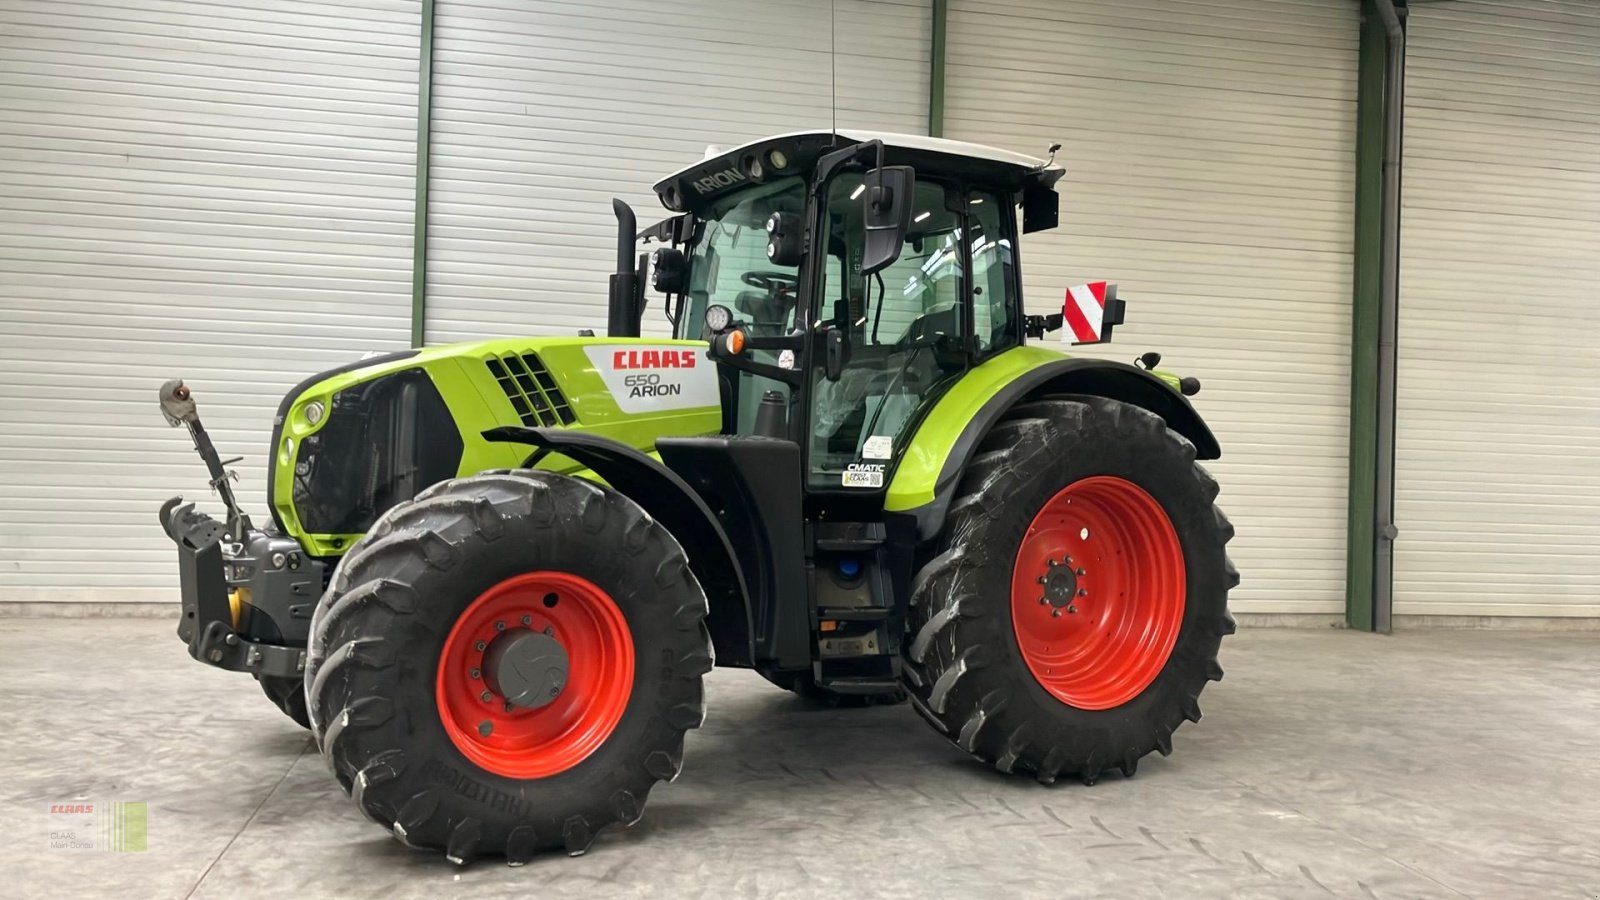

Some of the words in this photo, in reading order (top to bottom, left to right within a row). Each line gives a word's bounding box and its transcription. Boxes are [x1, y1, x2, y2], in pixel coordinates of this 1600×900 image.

[693, 167, 746, 195] ARION
[613, 350, 696, 370] CLAAS
[624, 373, 661, 387] 650
[629, 383, 681, 398] ARION
[847, 463, 886, 472] CMATIC
